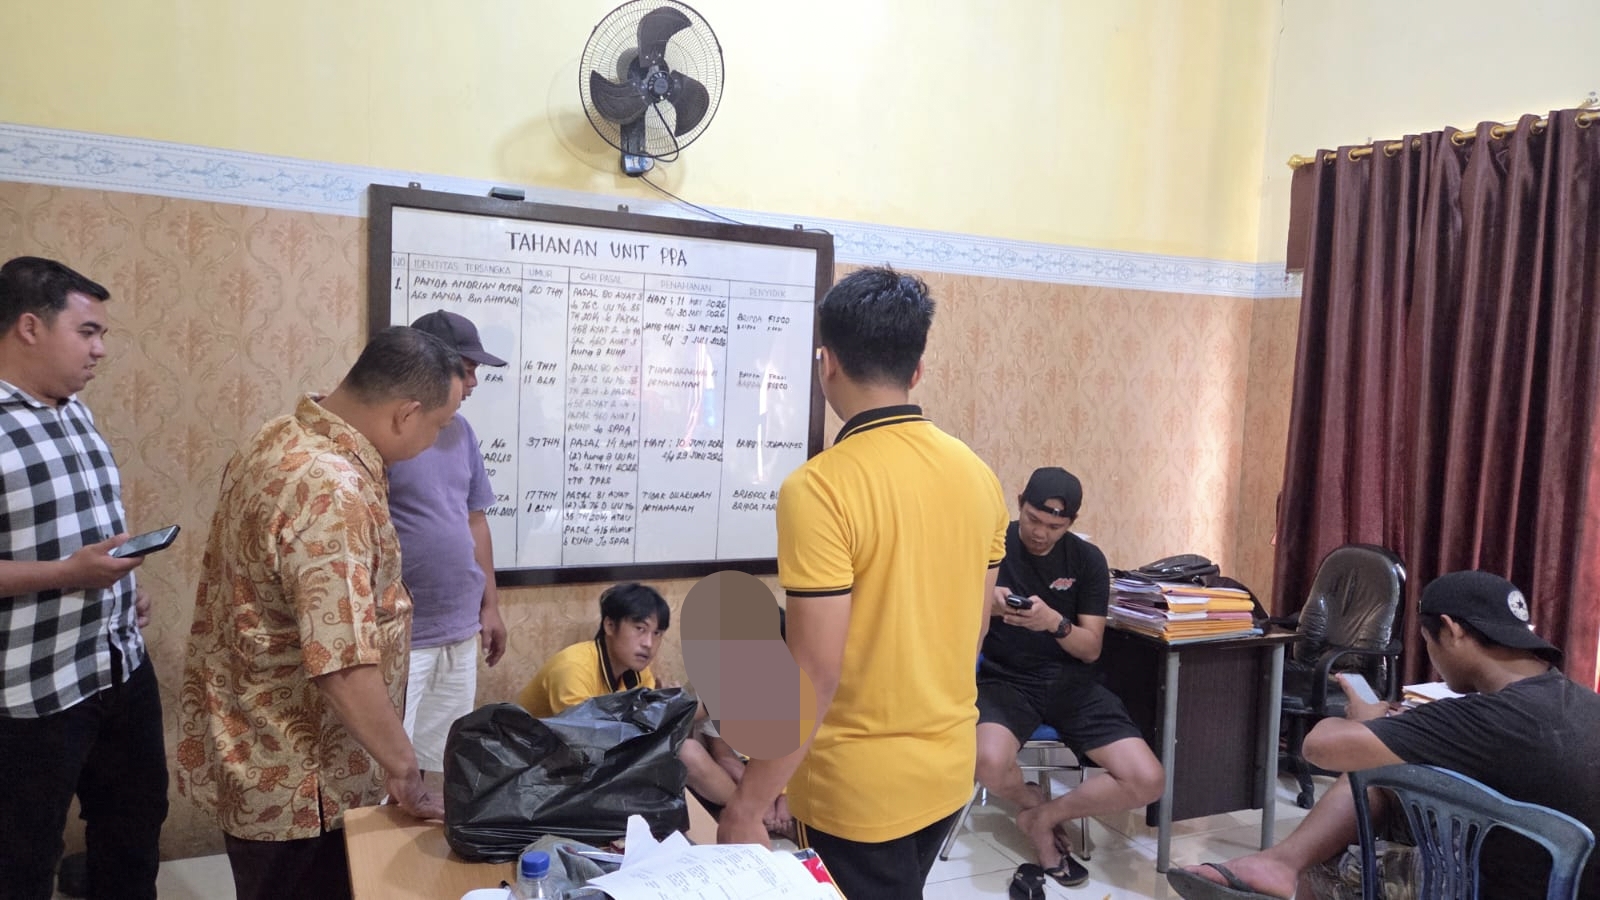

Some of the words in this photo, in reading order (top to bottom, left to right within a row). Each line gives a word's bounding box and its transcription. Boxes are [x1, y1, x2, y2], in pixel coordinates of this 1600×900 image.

[505, 231, 597, 256] TAHANAN
[610, 241, 649, 261] UNIT
[660, 247, 687, 267] PPA
[392, 257, 405, 267] NO
[414, 259, 458, 271] IDENTITAS
[464, 263, 511, 274] TERSANGKA
[529, 268, 552, 278] UMUR
[414, 277, 448, 289] PANDA
[452, 279, 496, 291] ANDRIAN
[599, 274, 622, 284] PASAL
[529, 285, 543, 295] 20
[660, 280, 712, 292] PENAHANAN
[431, 291, 462, 303] PANDA
[573, 287, 599, 299] PASAL
[615, 292, 635, 301] AYAT
[646, 294, 667, 305] HAN
[706, 299, 727, 309] 2026
[705, 309, 726, 319] 2026
[526, 436, 541, 448] 37
[570, 438, 600, 449] PASAL
[643, 438, 666, 448] HAN
[565, 490, 592, 500] PASAL
[563, 524, 590, 535] PASAL
